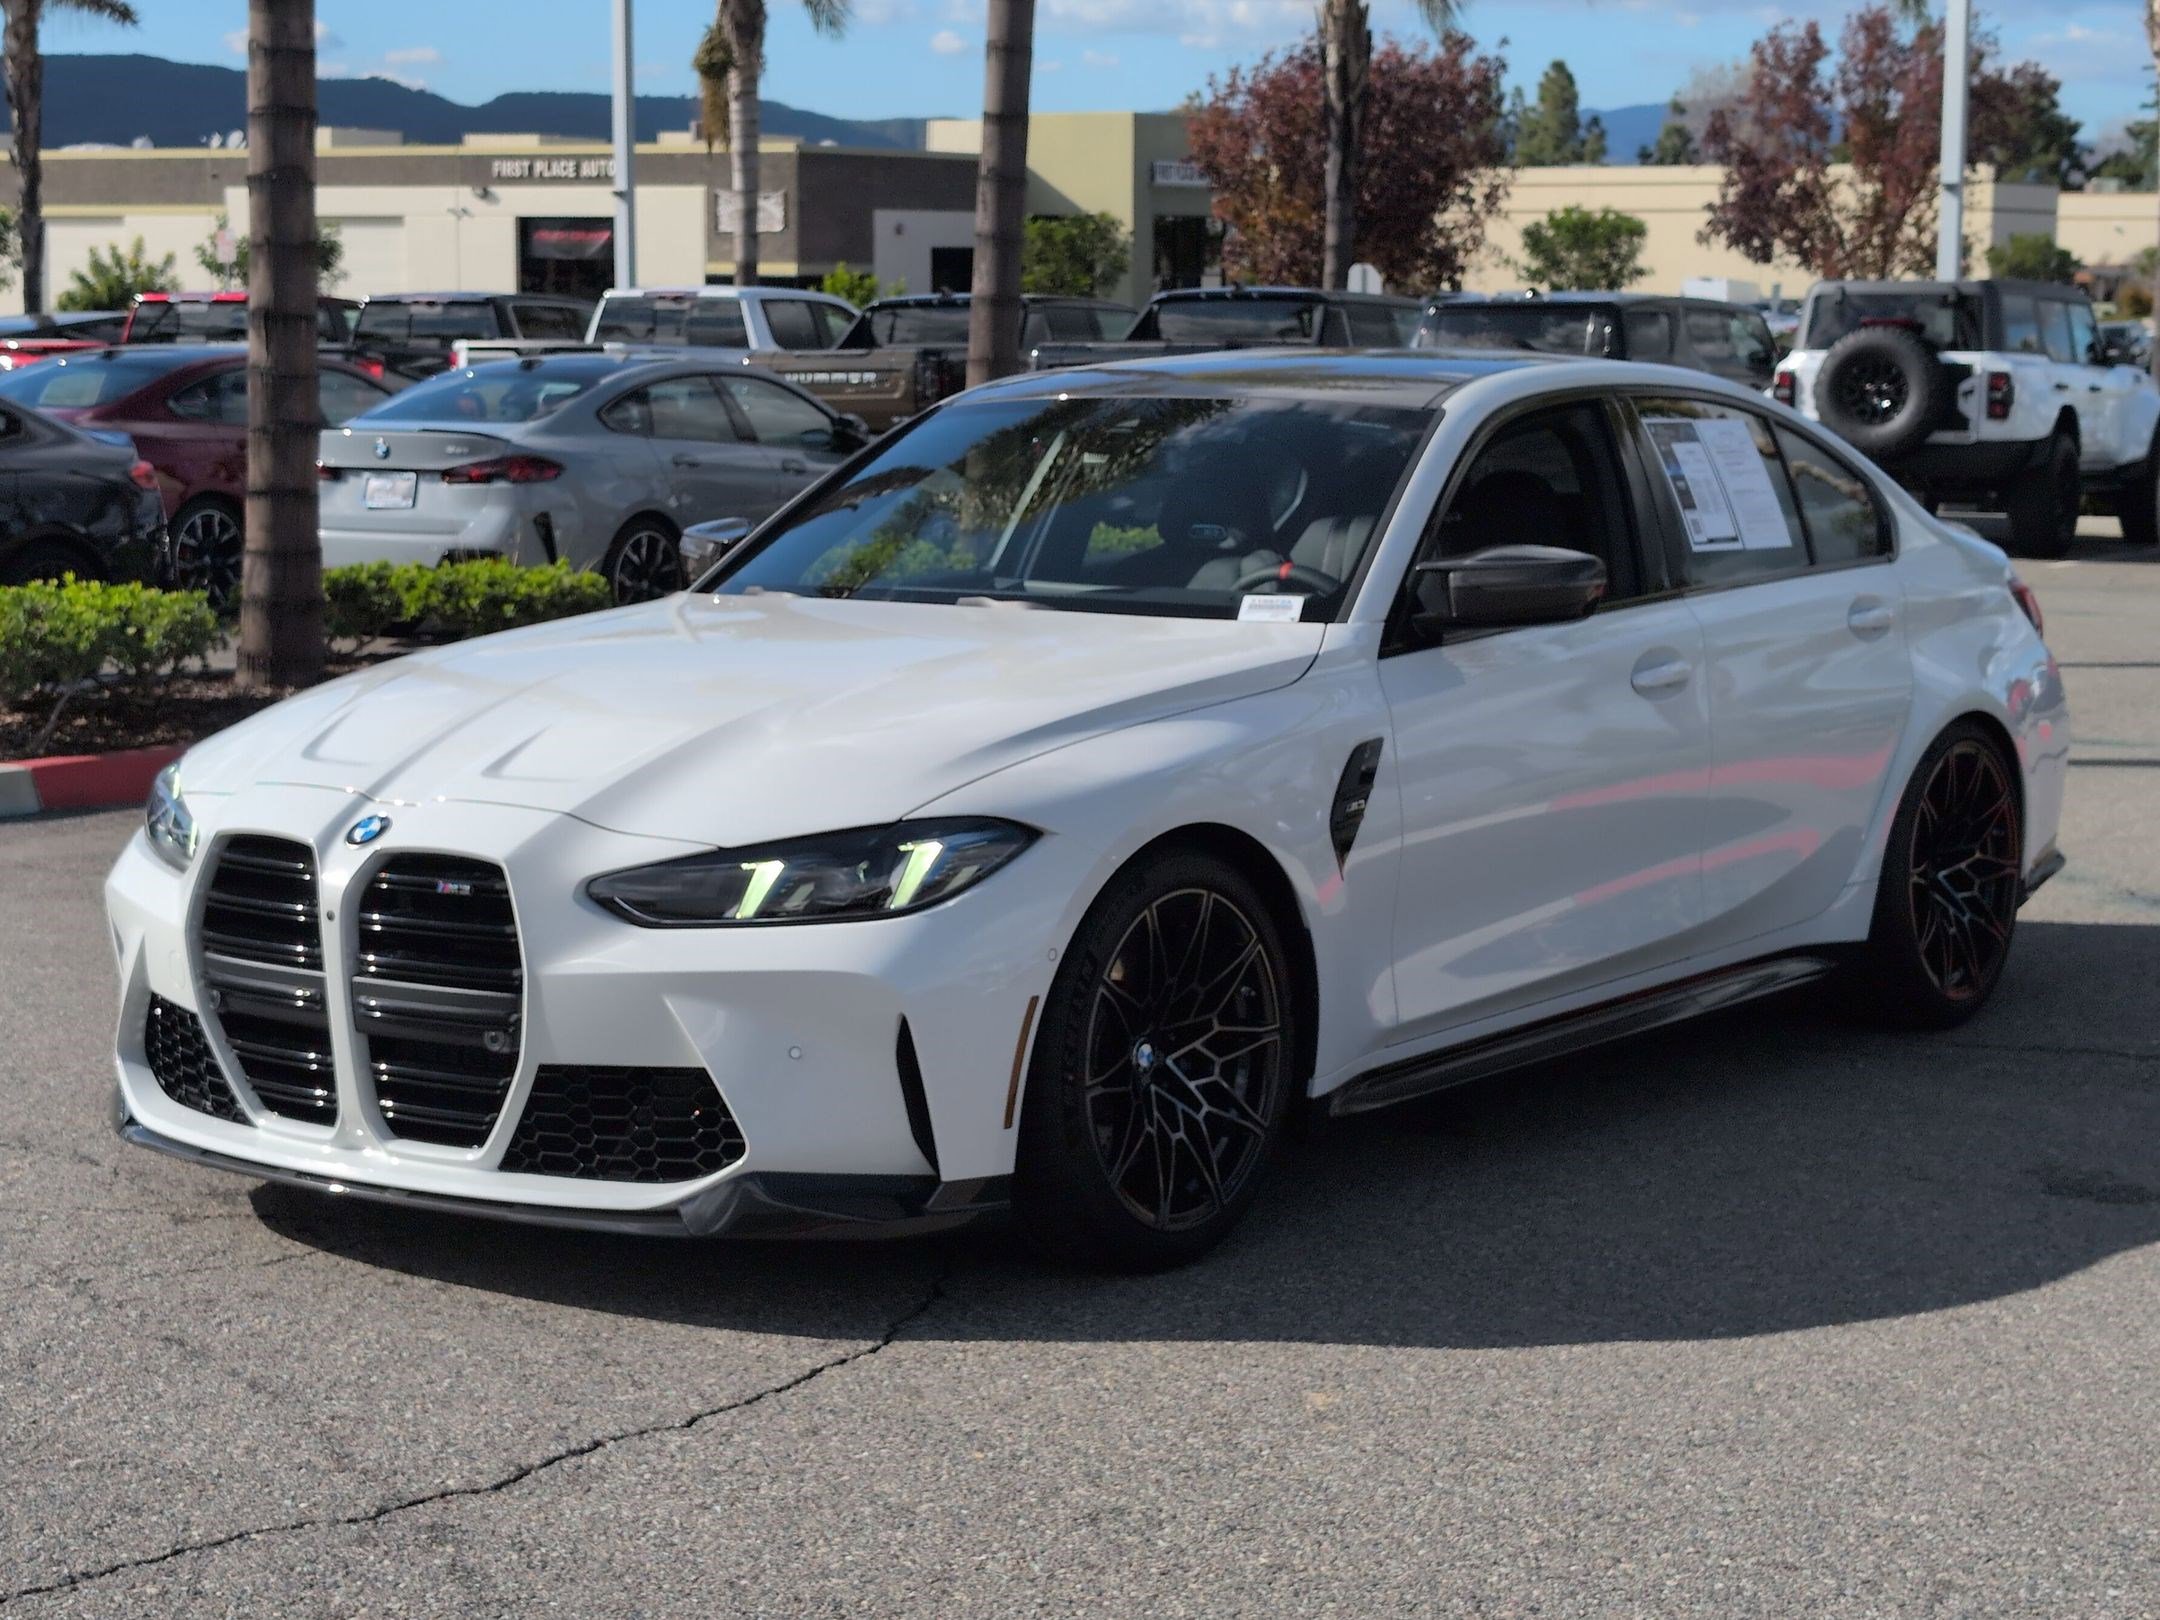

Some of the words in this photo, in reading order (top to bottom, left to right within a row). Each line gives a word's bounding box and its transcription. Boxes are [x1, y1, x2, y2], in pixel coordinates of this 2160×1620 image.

[492, 159, 530, 177] FIRST
[533, 159, 577, 177] PLACE
[580, 159, 616, 177] AUTO
